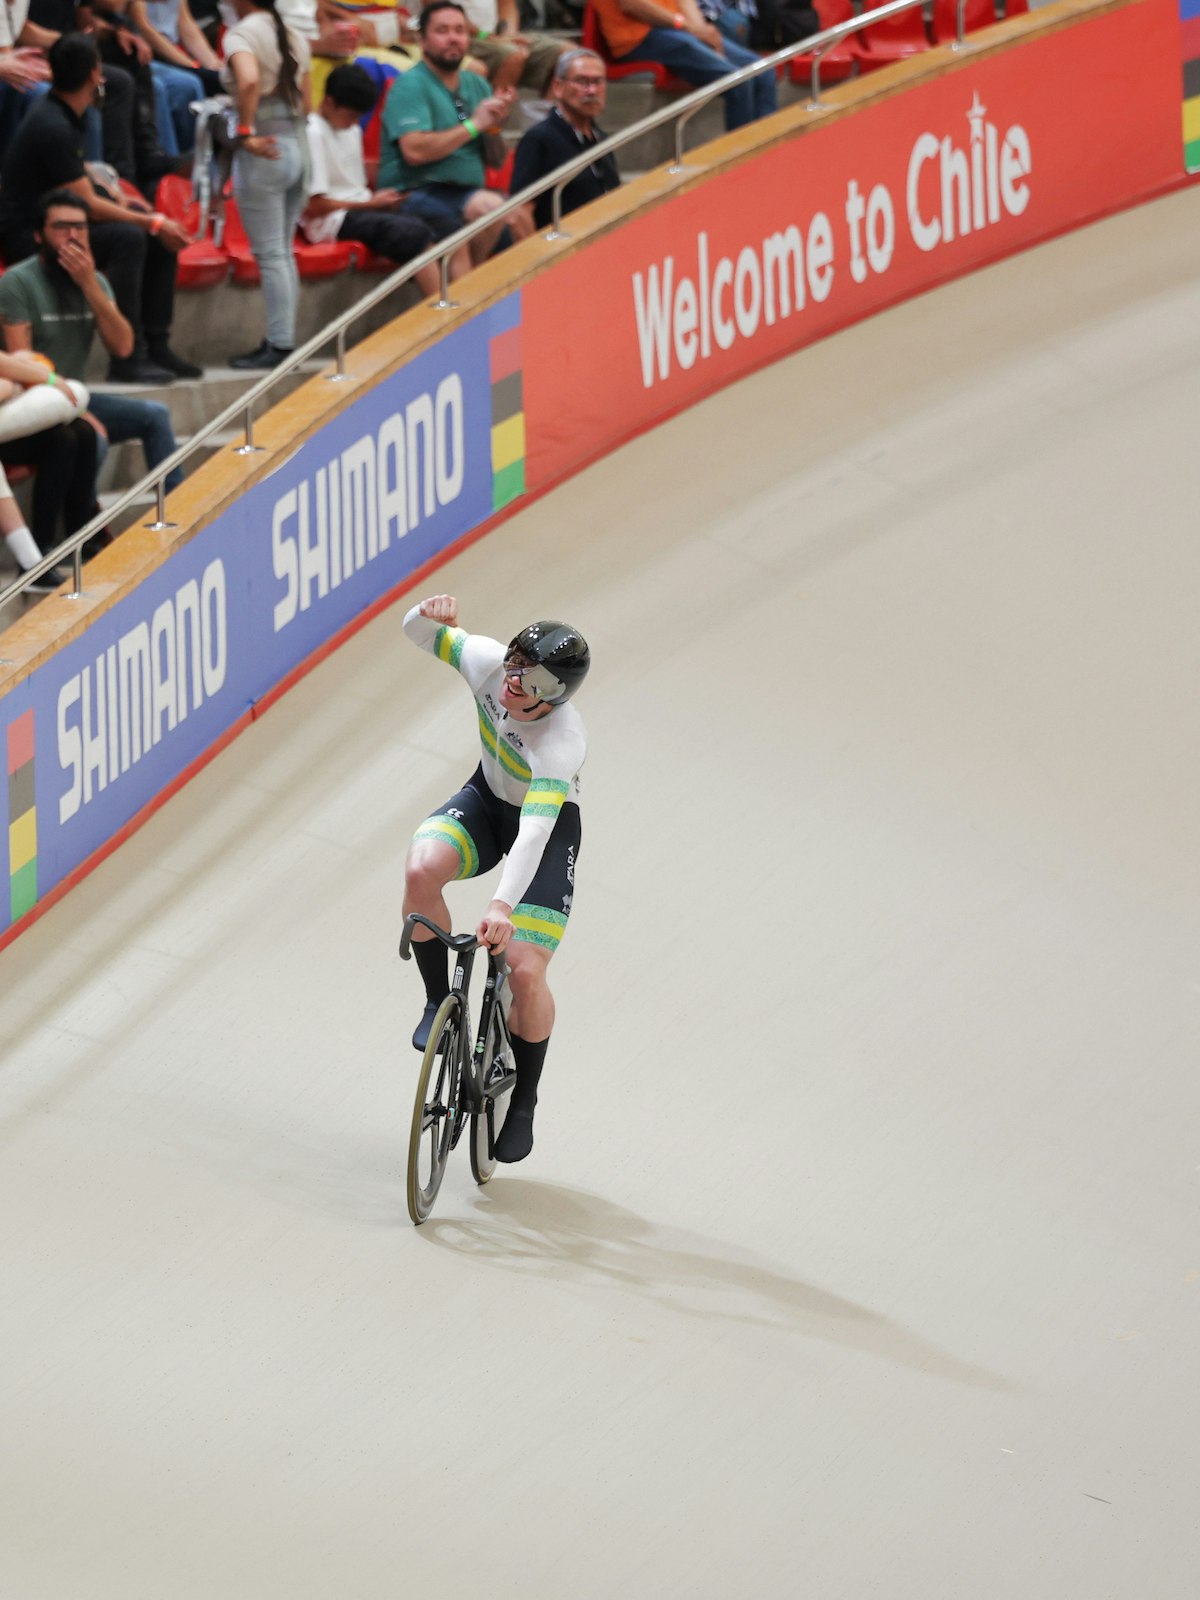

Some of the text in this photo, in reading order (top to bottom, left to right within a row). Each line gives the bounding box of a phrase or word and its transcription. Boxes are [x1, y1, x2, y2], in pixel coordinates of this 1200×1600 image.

[632, 90, 1032, 389] Welcome to Chile
[271, 371, 465, 634] SHIMANO
[56, 556, 230, 828] SHIMANO
